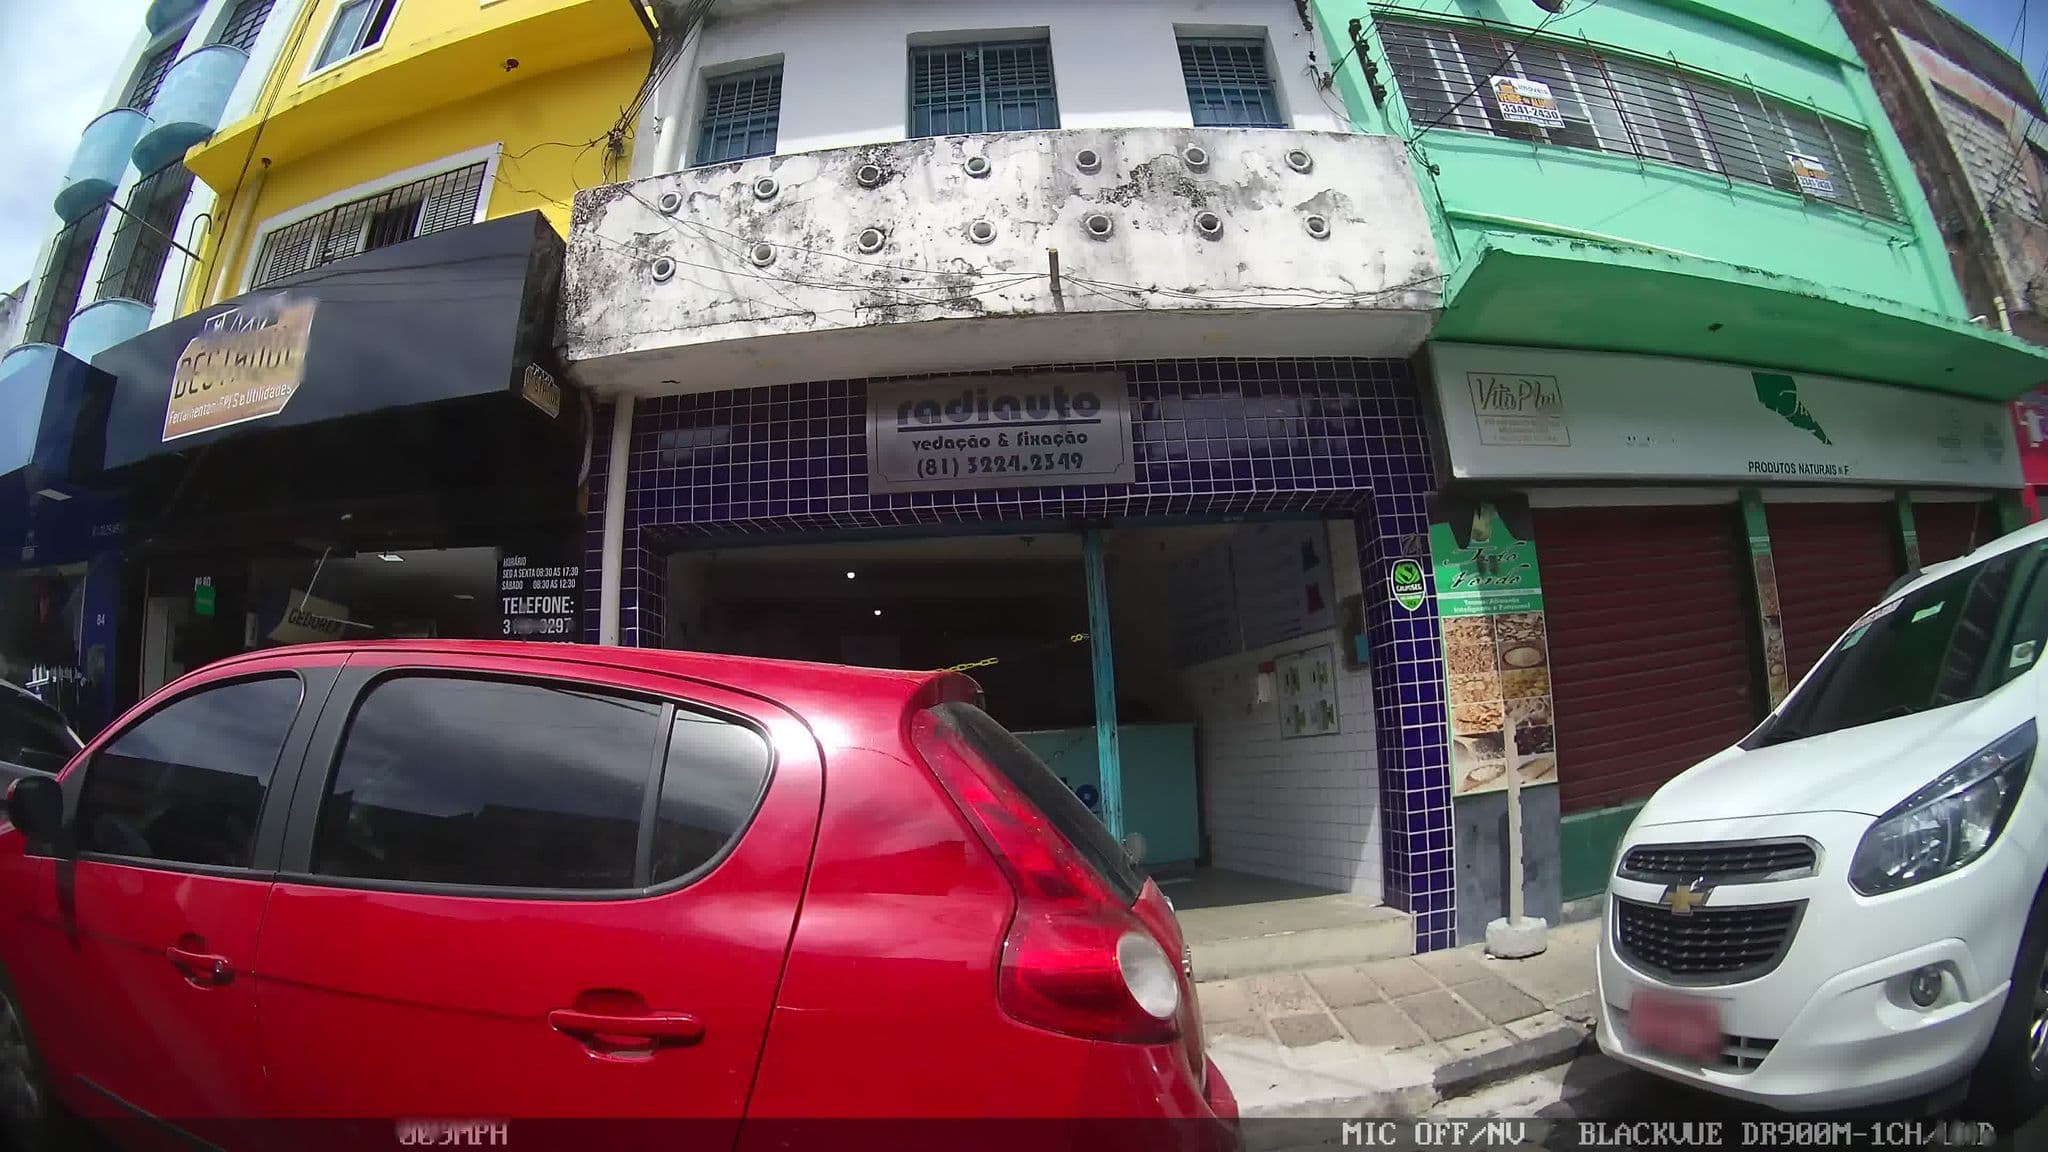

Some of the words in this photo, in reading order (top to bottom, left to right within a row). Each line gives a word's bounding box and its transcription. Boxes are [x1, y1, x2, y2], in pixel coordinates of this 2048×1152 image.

[1502, 103, 1559, 120] 3341-2430
[246, 383, 292, 403] Utilidades
[897, 386, 1100, 425] radiauto
[912, 435, 990, 452] vedação
[998, 432, 1009, 447] &
[1017, 431, 1088, 448] fixação
[917, 456, 959, 478] (81)
[968, 452, 1083, 474] 3224.2349
[1748, 461, 1796, 474] PRODUTOS
[1799, 463, 1837, 476] NATURAIS
[503, 569, 513, 579] SEG
[513, 568, 518, 578] A
[518, 568, 535, 578] SEXTA
[536, 567, 552, 577] 08:30
[563, 566, 579, 576] 17:30
[533, 579, 549, 589] 08:30
[560, 578, 575, 589] 12:30
[502, 596, 575, 614] TELEFONE:
